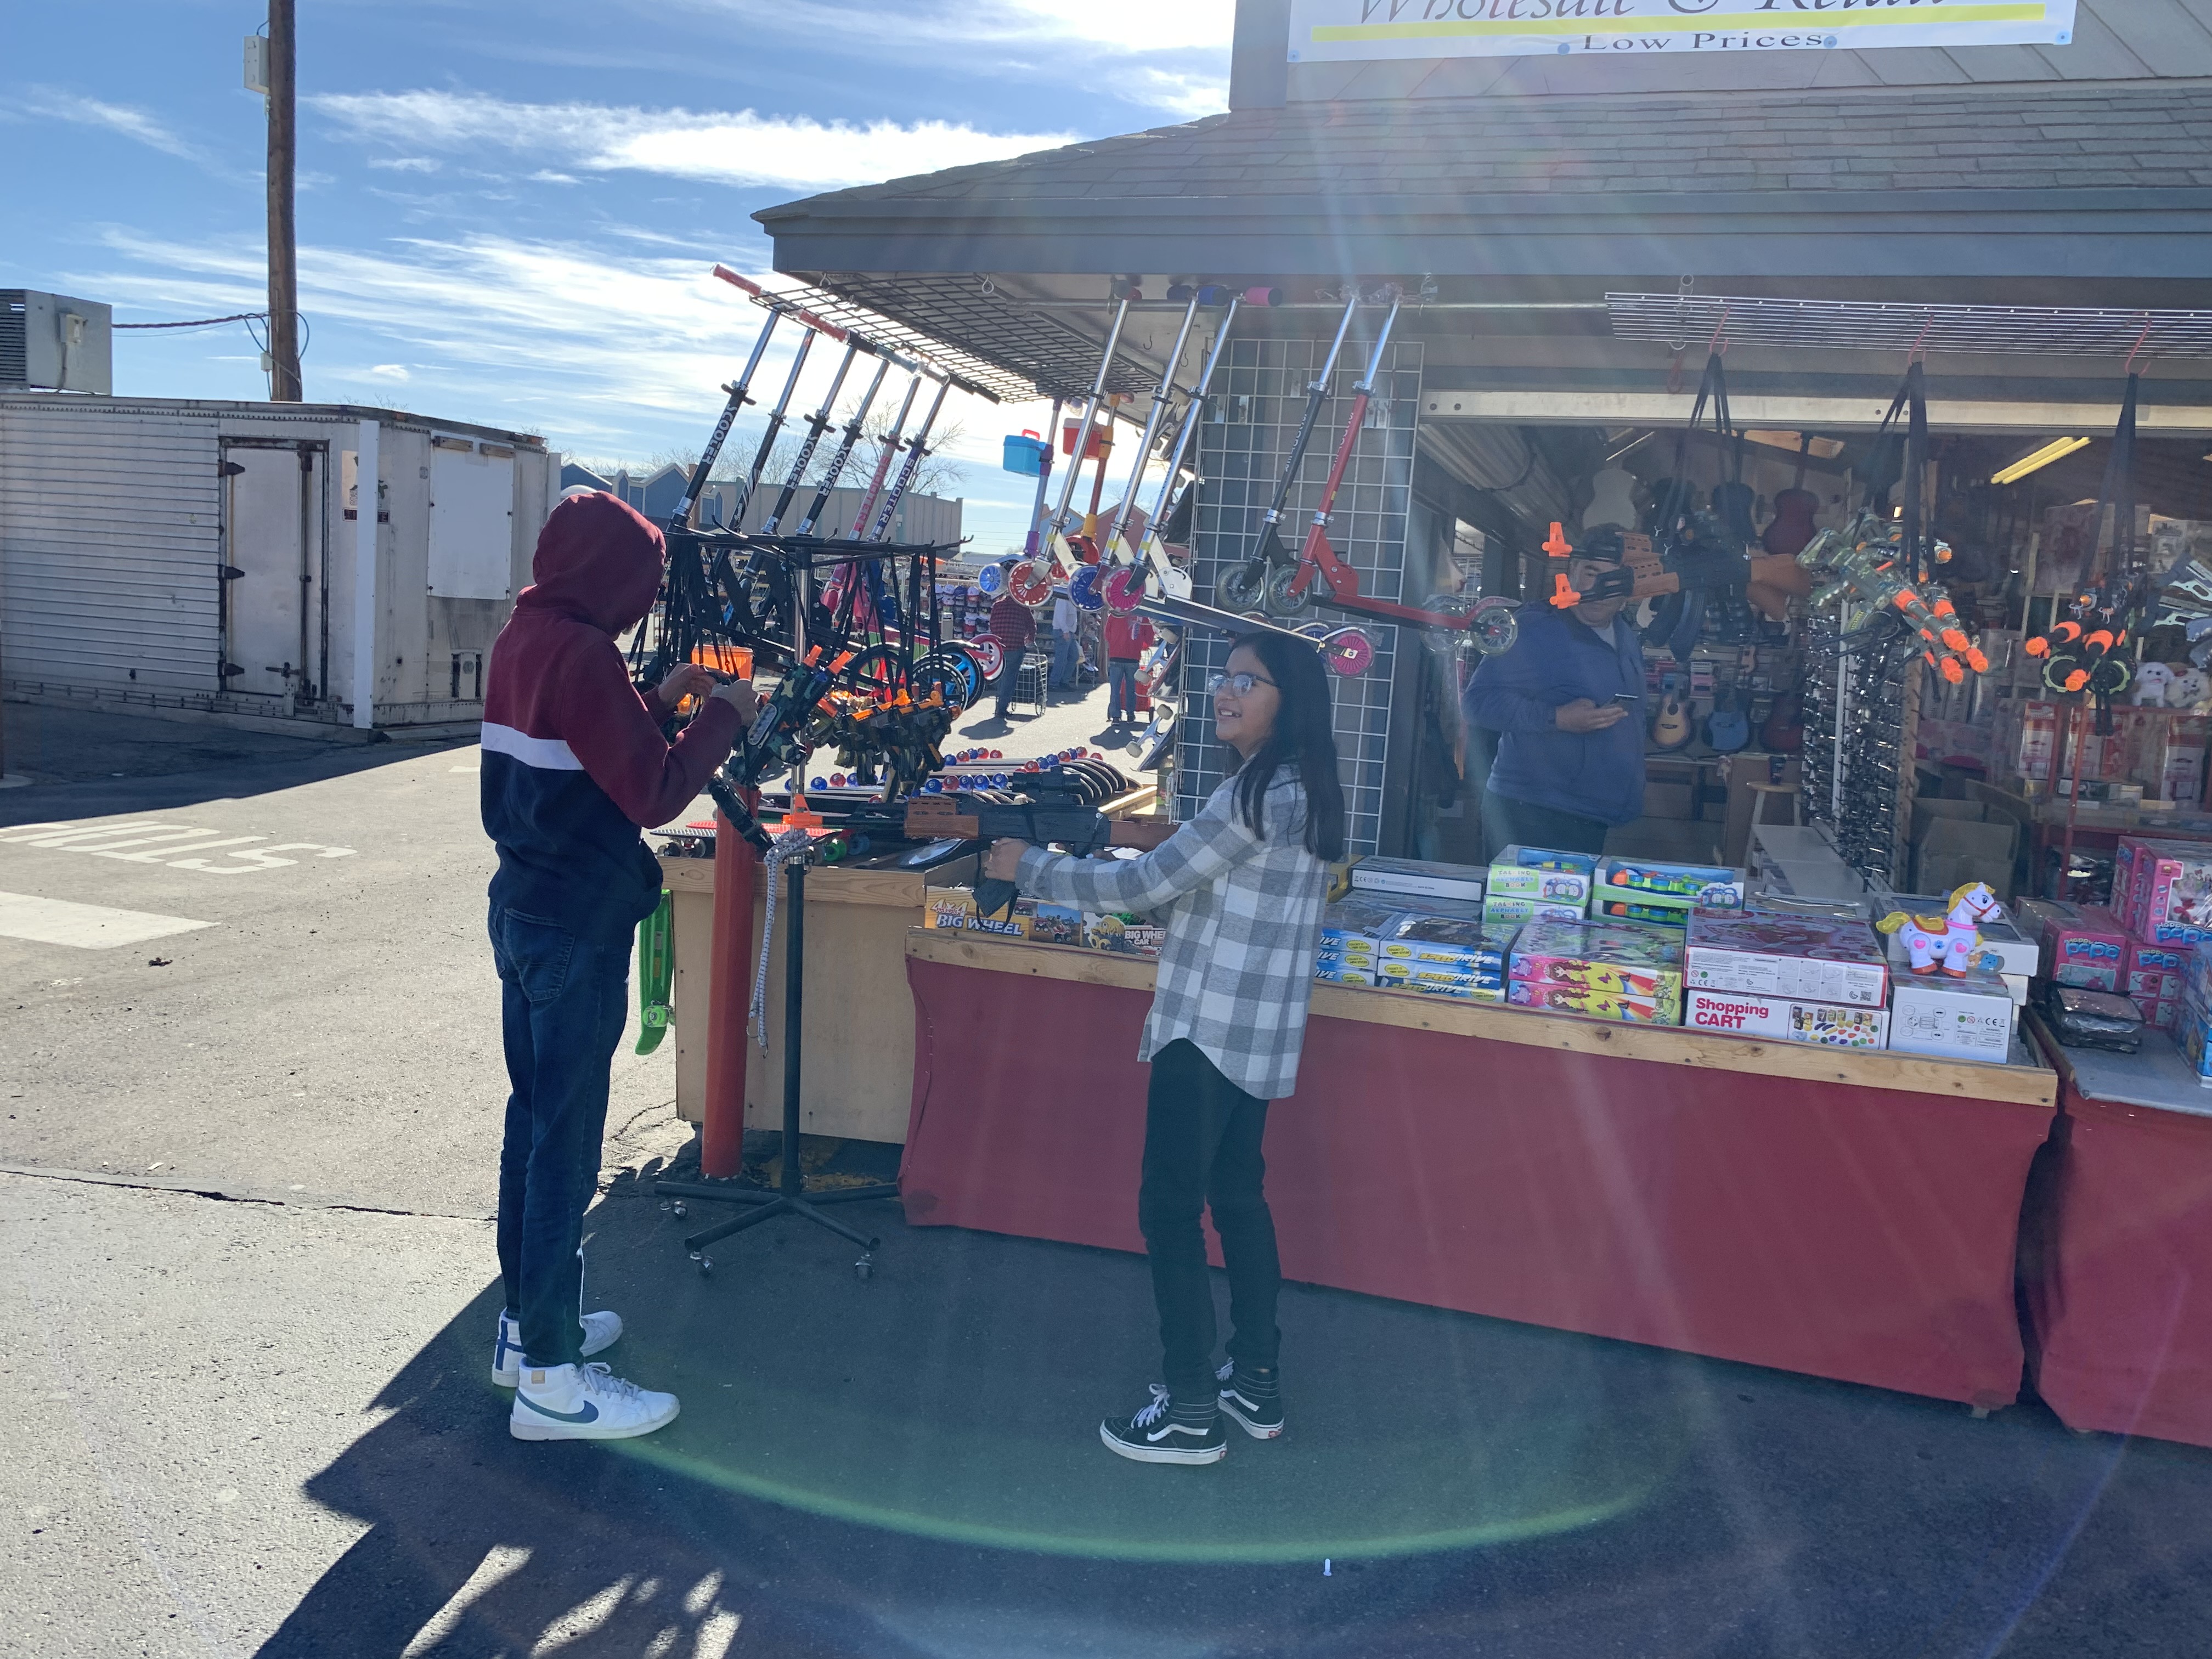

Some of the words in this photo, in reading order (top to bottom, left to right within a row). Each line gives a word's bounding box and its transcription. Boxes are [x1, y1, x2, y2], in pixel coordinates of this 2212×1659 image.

[1583, 35, 1672, 50] Low
[1691, 32, 1823, 49] Prices
[702, 404, 737, 465] SCOOTER
[786, 433, 818, 490] SCOOTER
[819, 443, 850, 496] SCOOTER
[880, 458, 915, 523] SCOOTER
[936, 914, 964, 928] BIG
[967, 918, 1023, 936] WHEEL
[1124, 930, 1141, 939] BIG
[1418, 953, 1457, 963] SPEED
[1448, 952, 1495, 964] DRIVE
[1417, 972, 1455, 982] SPEED
[1446, 972, 1492, 984] DRIVE
[1696, 997, 1769, 1019] Shopping
[1695, 1012, 1746, 1029] CART
